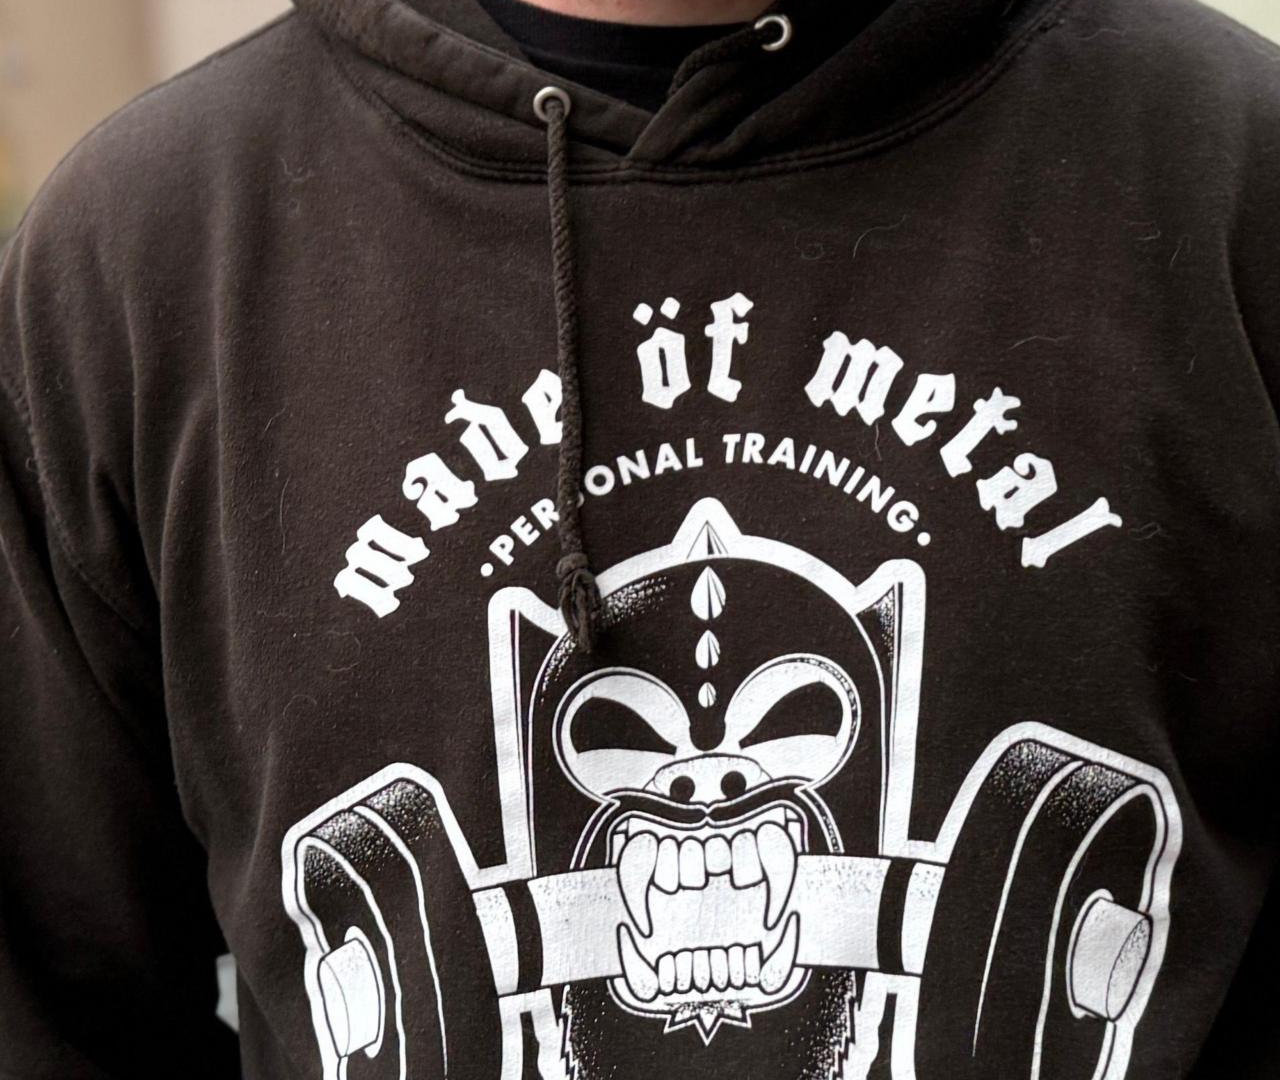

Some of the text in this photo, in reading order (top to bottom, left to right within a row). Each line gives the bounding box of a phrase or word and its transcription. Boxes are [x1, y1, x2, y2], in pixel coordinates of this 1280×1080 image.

[333, 291, 1123, 618] made öf metal
[488, 432, 920, 567] PERONAL TRAINING
